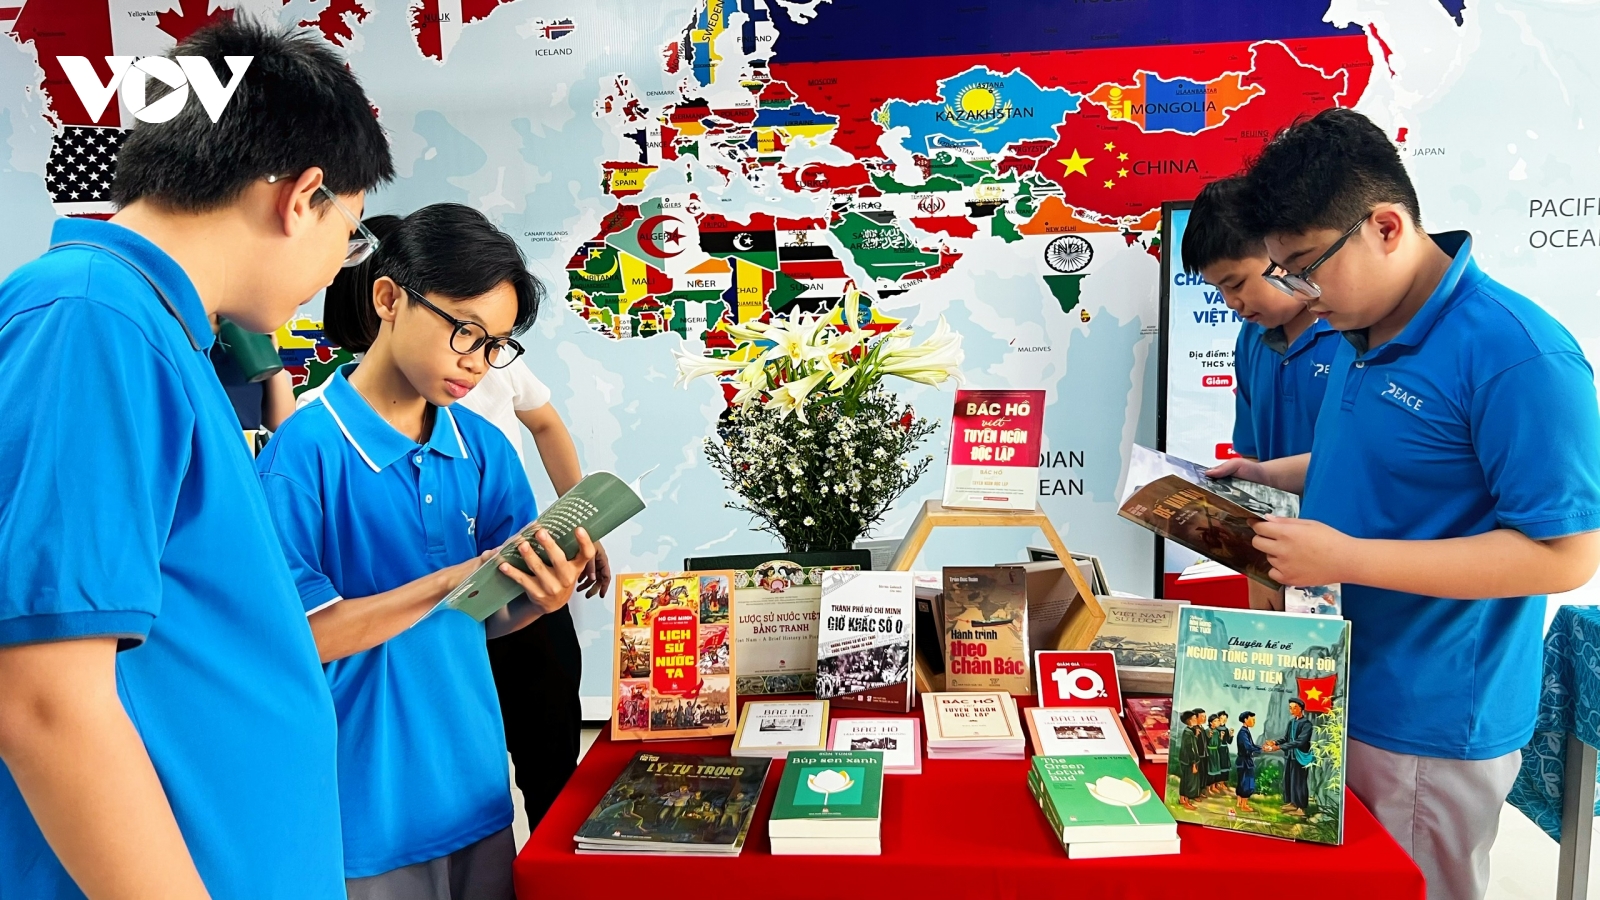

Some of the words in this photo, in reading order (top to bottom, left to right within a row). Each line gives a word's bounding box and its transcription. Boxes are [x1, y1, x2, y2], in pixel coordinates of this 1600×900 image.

[424, 13, 450, 21] NUUK
[702, 0, 725, 42] SWEDEN
[535, 48, 573, 56] ICELAND
[1131, 101, 1217, 115] MONGOLIA
[935, 106, 1034, 122] KAZAKHSTAN
[1240, 130, 1269, 138] BEIJING
[1413, 148, 1446, 156] JAPAN
[1133, 159, 1199, 176] CHINA
[615, 179, 637, 187] SPAIN
[857, 201, 882, 210] IRAQ
[640, 232, 679, 240] ALGERIA
[1529, 229, 1600, 249] OCEA
[632, 277, 656, 285] MALI
[687, 280, 716, 288] NIGER
[898, 278, 923, 290] YEMEN
[790, 283, 824, 291] SUDAN
[1193, 308, 1228, 327] VIỆT
[1189, 351, 1204, 360] Địa
[1201, 360, 1224, 368] THCS
[1206, 376, 1229, 386] Giảm
[1381, 381, 1424, 411] PEACE
[966, 400, 1002, 416] BÁC
[963, 427, 998, 444] TUYÊN
[1000, 428, 1029, 444] NGÔN
[970, 445, 993, 462] ĐỘC
[994, 445, 1016, 463] LẬP
[1039, 479, 1084, 496] EAN
[884, 607, 902, 615] MINH
[739, 614, 762, 625] LƯỢC
[878, 615, 894, 633] SỐ
[779, 623, 809, 633] TRANH
[659, 629, 691, 641] LỊCH
[951, 629, 973, 640] Hành
[975, 629, 998, 640] trình
[950, 640, 988, 657] theo
[951, 657, 992, 675] chân
[994, 657, 1025, 675] Bác
[1251, 651, 1274, 668] PHỤ
[1316, 656, 1336, 672] ĐỘI
[665, 667, 684, 679] TA
[792, 757, 817, 765] Búp
[1050, 774, 1077, 782] Bud
